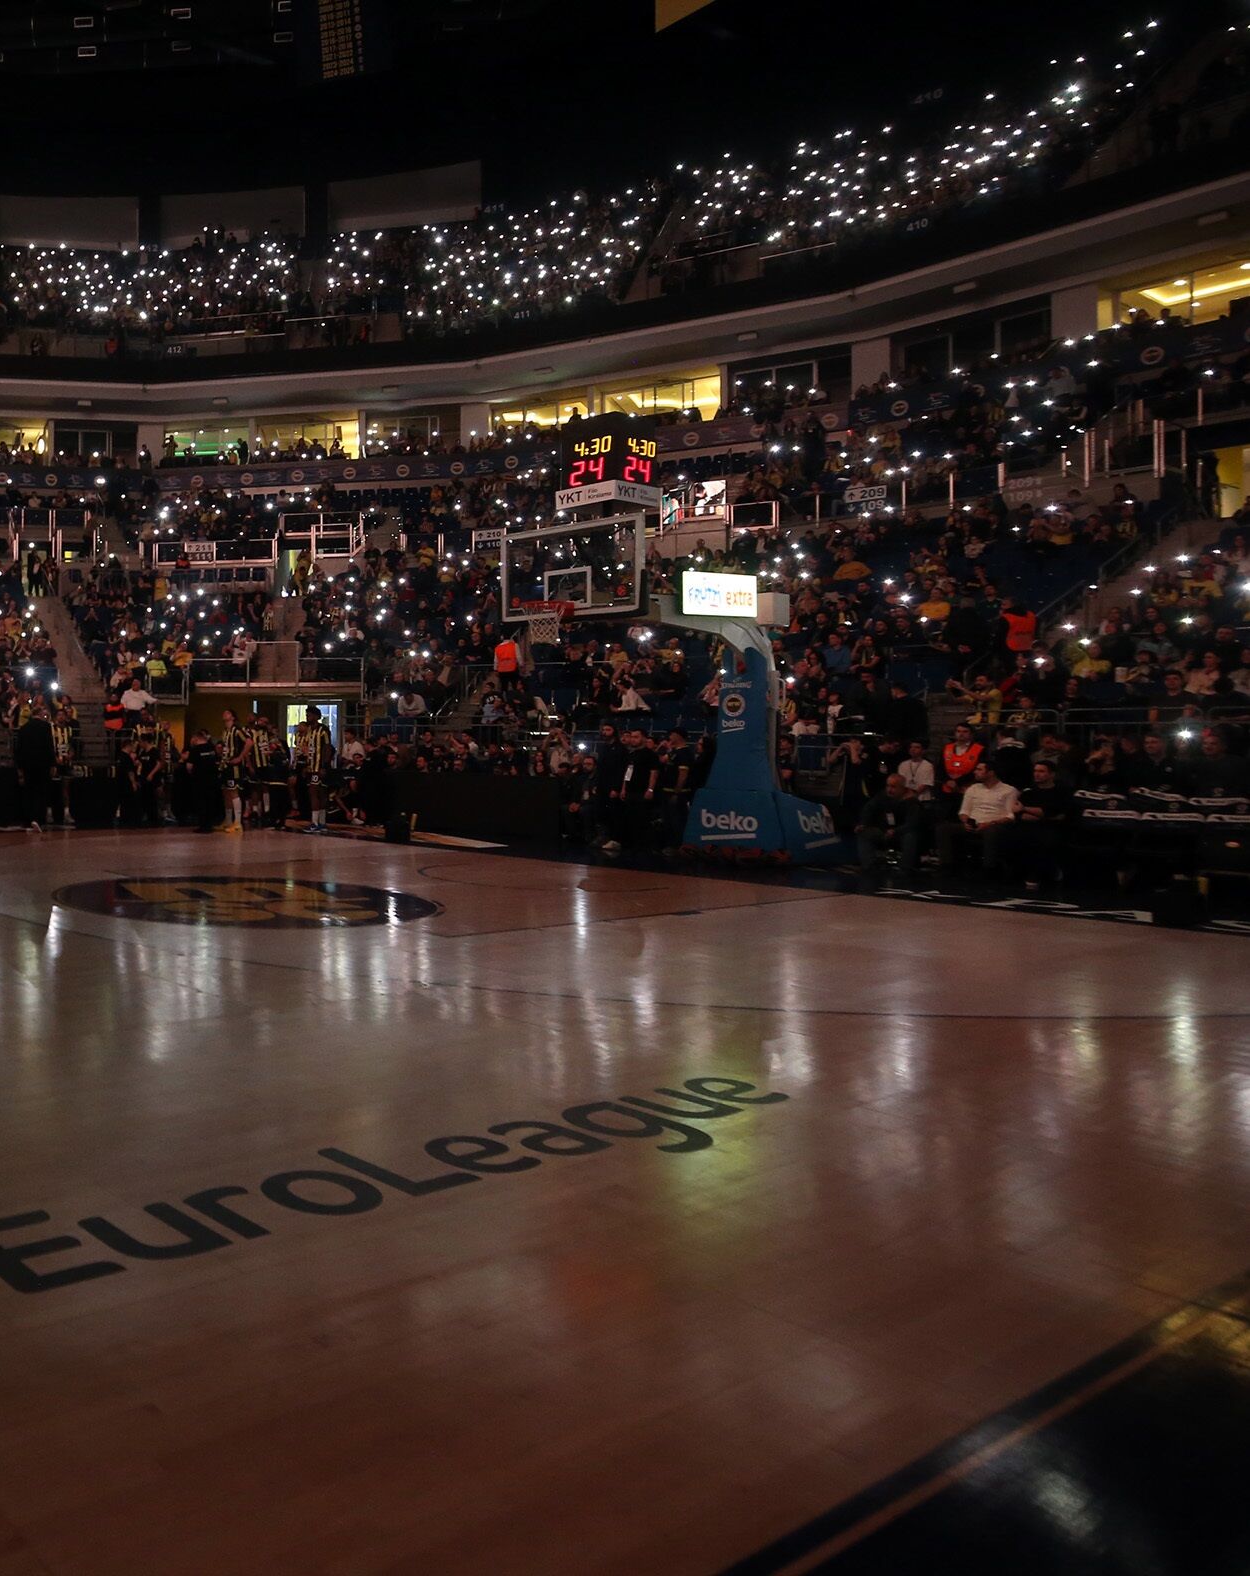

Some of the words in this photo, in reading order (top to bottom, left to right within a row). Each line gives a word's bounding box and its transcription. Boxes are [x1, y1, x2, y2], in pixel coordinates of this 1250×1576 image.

[906, 218, 929, 231] 410
[513, 310, 530, 319] 411
[574, 435, 612, 457] 4:30
[628, 437, 656, 458] 4:30
[569, 456, 606, 487] 24
[623, 455, 652, 483] 24
[558, 491, 583, 505] YKT
[618, 485, 637, 498] YKT
[861, 487, 885, 498] 209
[861, 500, 886, 512] 109
[195, 544, 211, 552] 211
[721, 718, 746, 728] beko
[701, 808, 759, 832] beko
